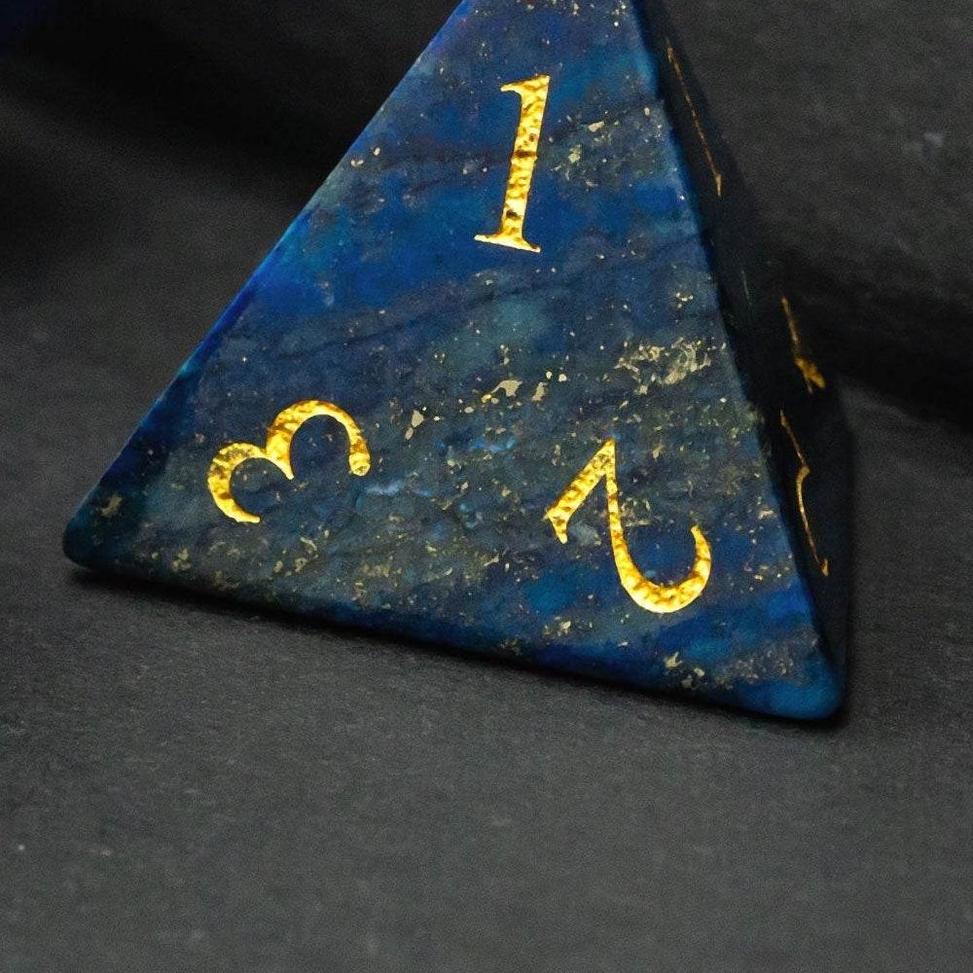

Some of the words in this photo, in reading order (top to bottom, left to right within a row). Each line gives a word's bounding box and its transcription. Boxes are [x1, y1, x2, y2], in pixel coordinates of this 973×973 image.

[475, 74, 551, 254] 1
[207, 399, 372, 524] 3
[545, 439, 712, 615] 2
